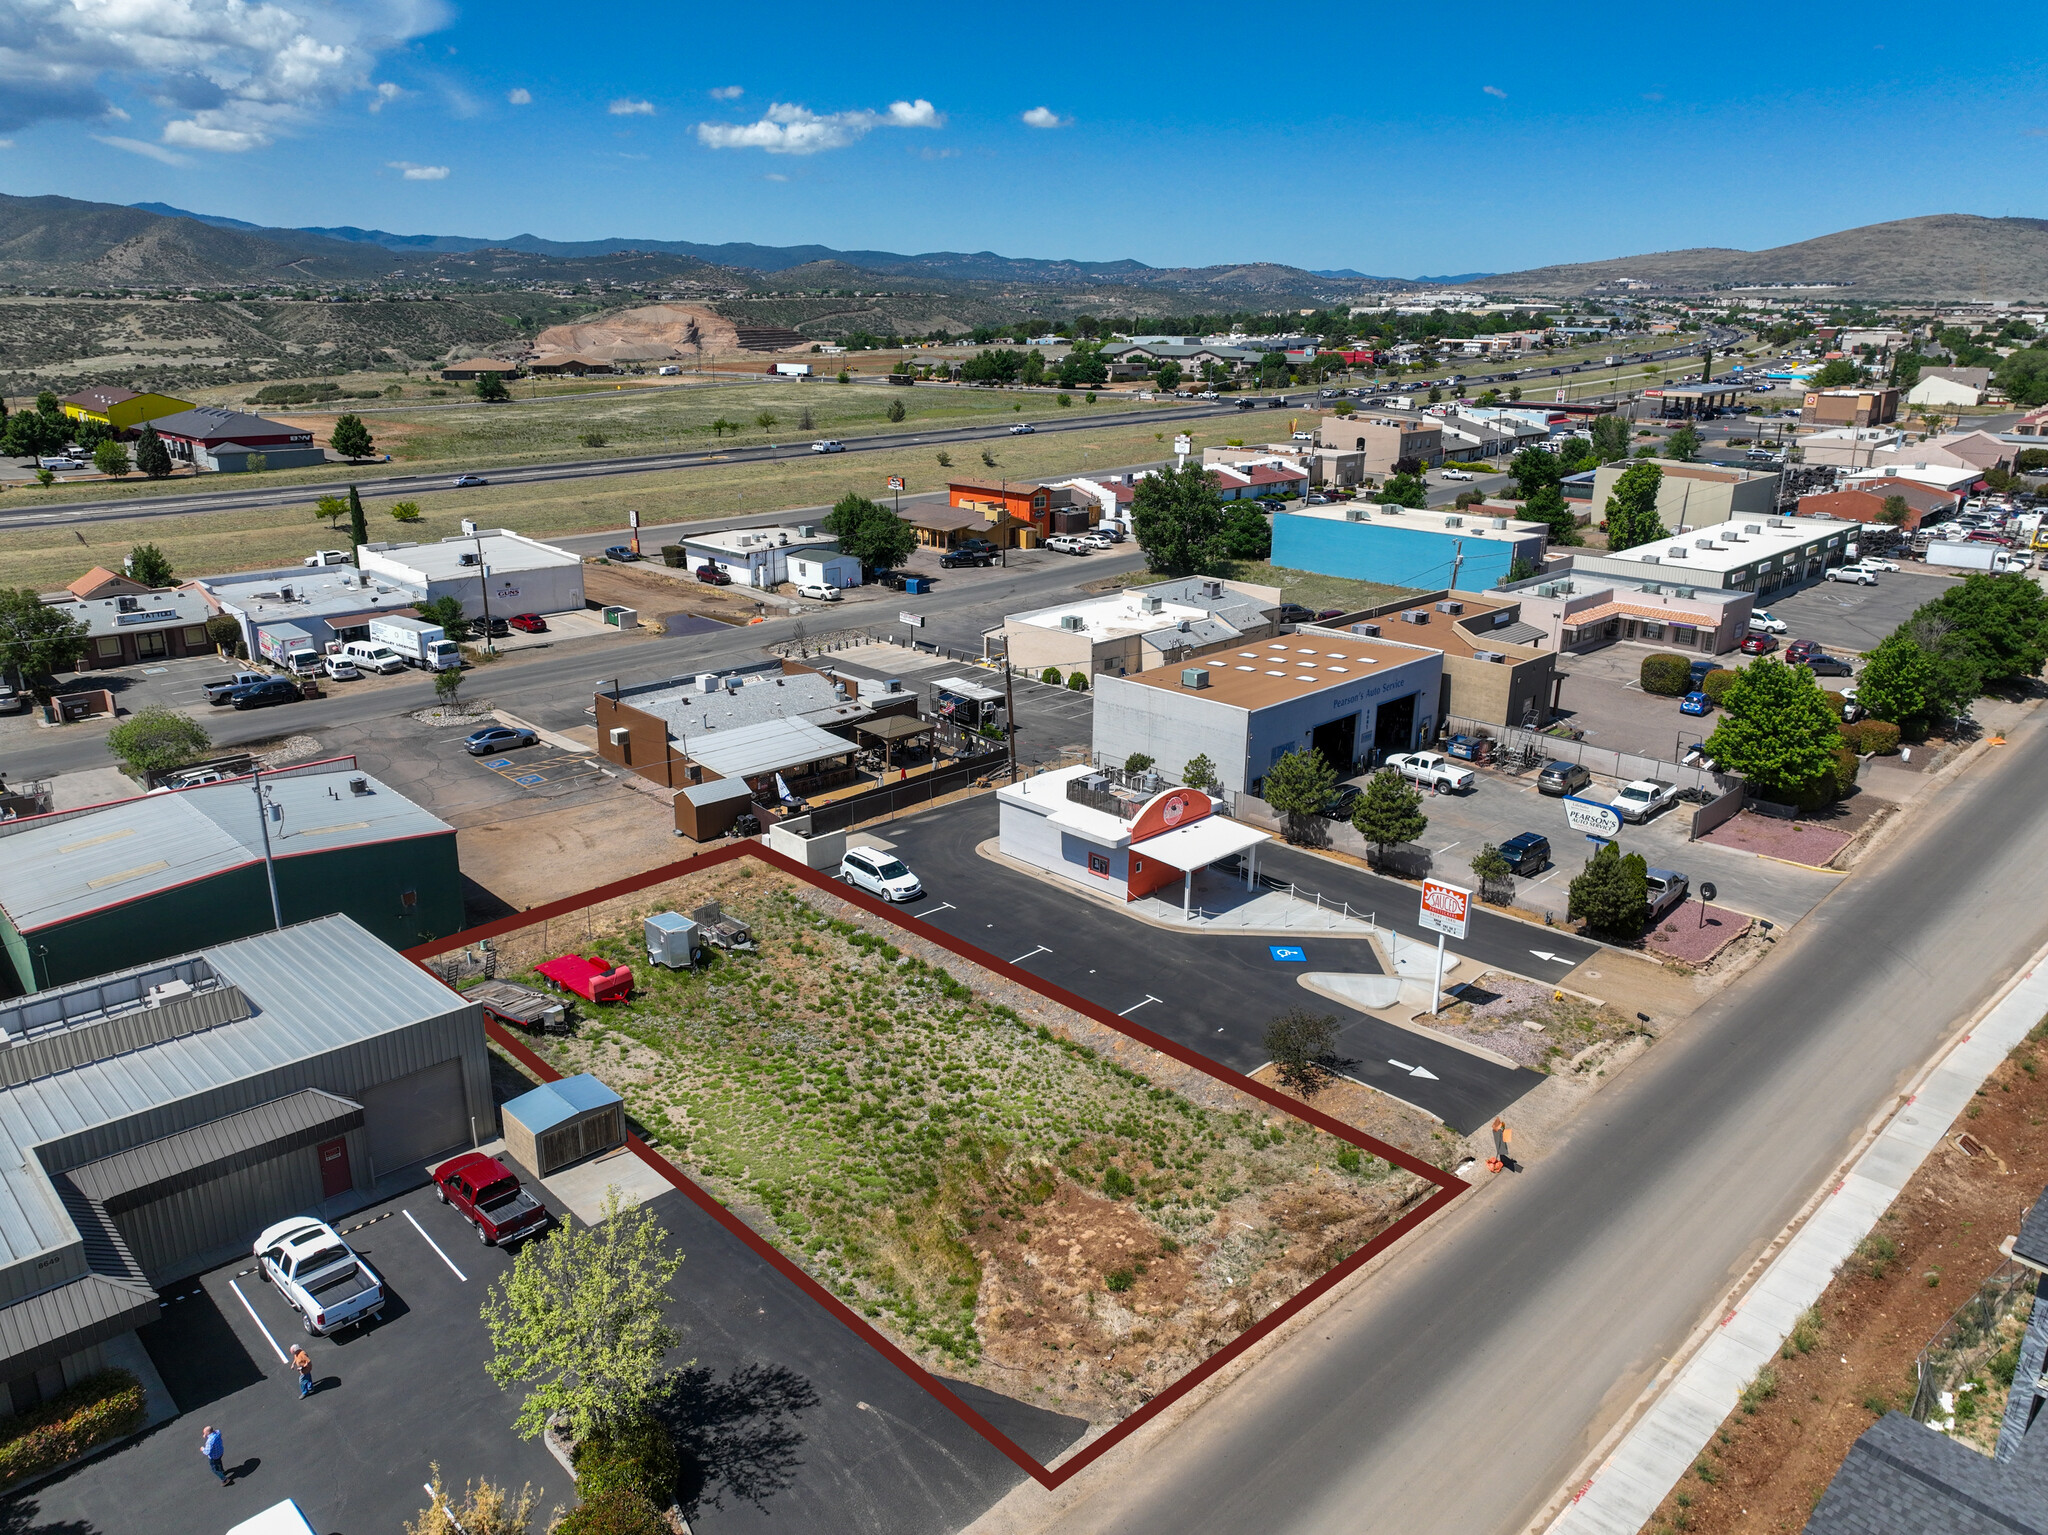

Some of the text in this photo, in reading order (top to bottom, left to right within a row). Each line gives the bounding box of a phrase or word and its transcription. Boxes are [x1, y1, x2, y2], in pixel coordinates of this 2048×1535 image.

[140, 610, 172, 619] TATTOO
[396, 643, 418, 651] LOCATIONS
[1333, 680, 1405, 709] Pearson's Auto Service
[1570, 811, 1616, 828] PEARSON'S
[1590, 821, 1612, 831] SERVICE
[1431, 894, 1457, 912] SAUCED
[38, 1256, 60, 1269] 8649
